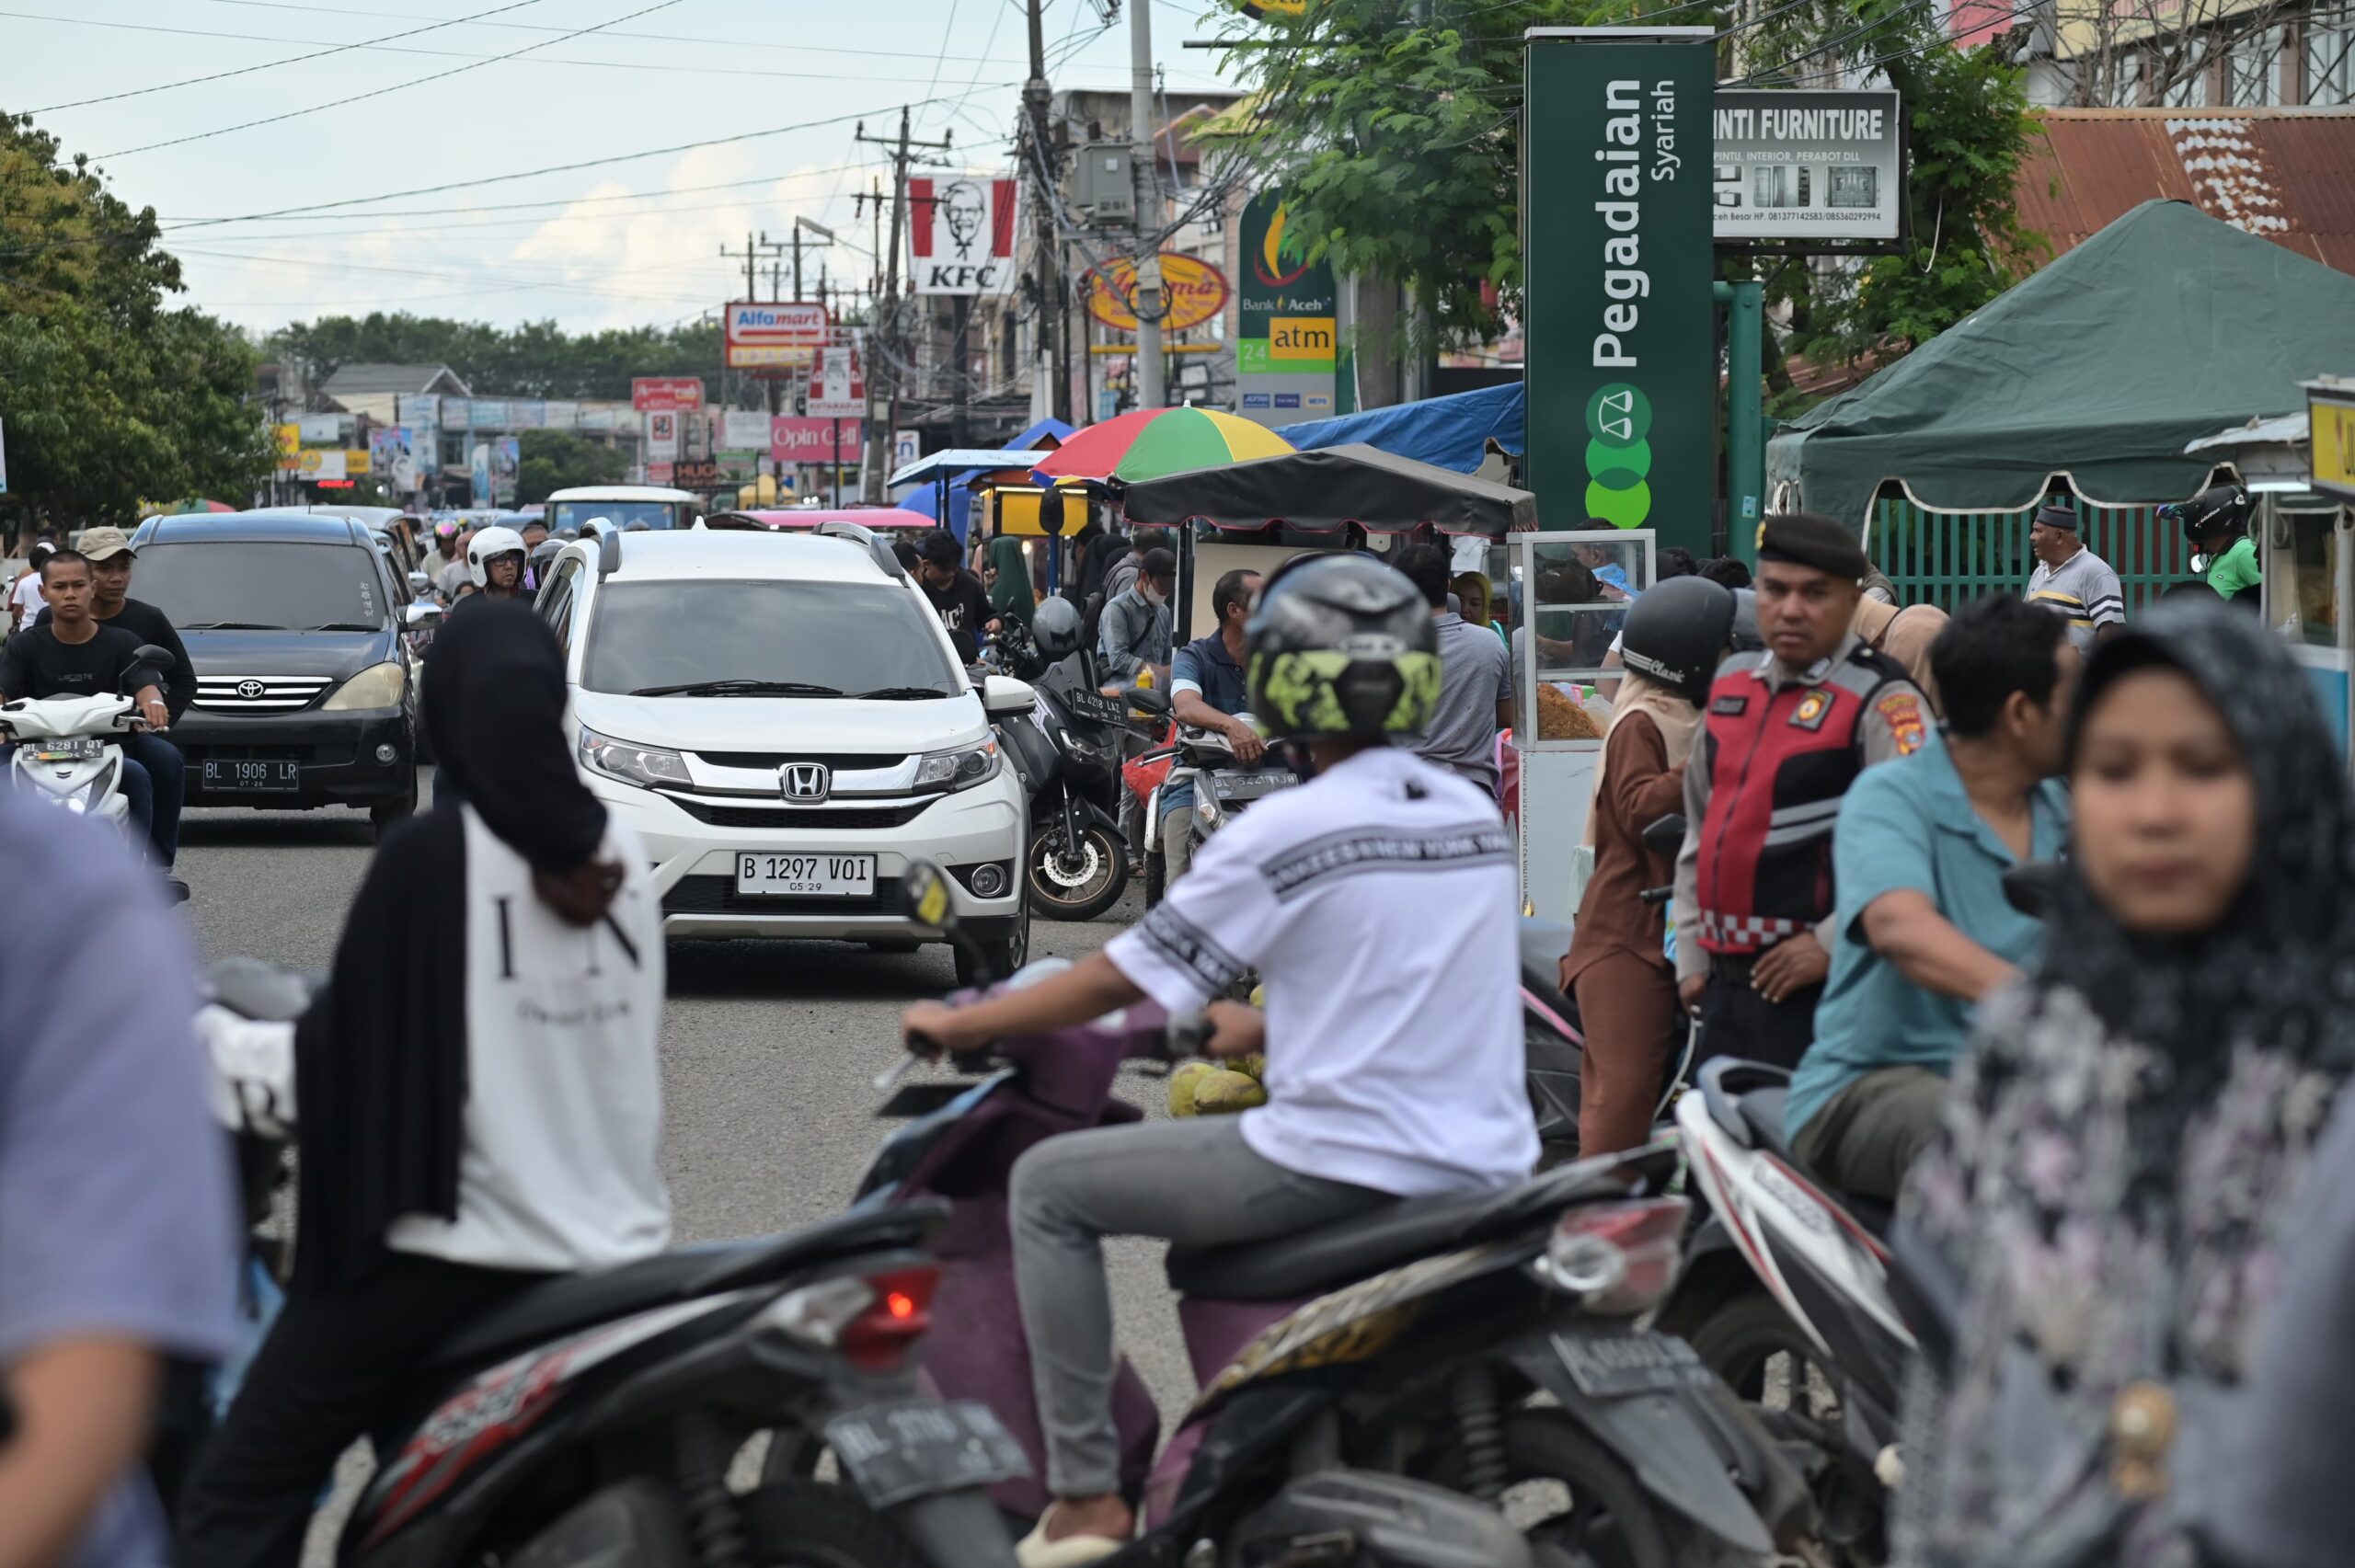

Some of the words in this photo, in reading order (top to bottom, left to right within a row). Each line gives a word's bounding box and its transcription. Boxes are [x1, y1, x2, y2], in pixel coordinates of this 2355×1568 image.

[1650, 80, 1682, 181] Syariah
[1761, 109, 1883, 140] FURNITURE
[1797, 152, 1842, 161] PERABOT
[1844, 152, 1860, 161] DLL
[1592, 80, 1649, 367] Pegadaian
[1713, 212, 1729, 221] ceh
[1730, 212, 1752, 221] Besar
[929, 266, 996, 288] KFC
[1243, 299, 1274, 311] Bank
[1288, 299, 1322, 311] Aceh
[739, 311, 820, 325] Alfamart
[1274, 325, 1329, 348] atm
[1244, 344, 1266, 360] 24
[774, 427, 819, 450] Opin
[1076, 692, 1086, 704] BL
[23, 744, 39, 752] BL
[47, 741, 79, 750] 6281
[205, 762, 222, 779] BL
[236, 763, 268, 779] 1906
[280, 763, 297, 780] LR
[1214, 777, 1230, 788] BL
[744, 857, 755, 879] B
[765, 858, 817, 880] 1297
[829, 858, 867, 881] VOI
